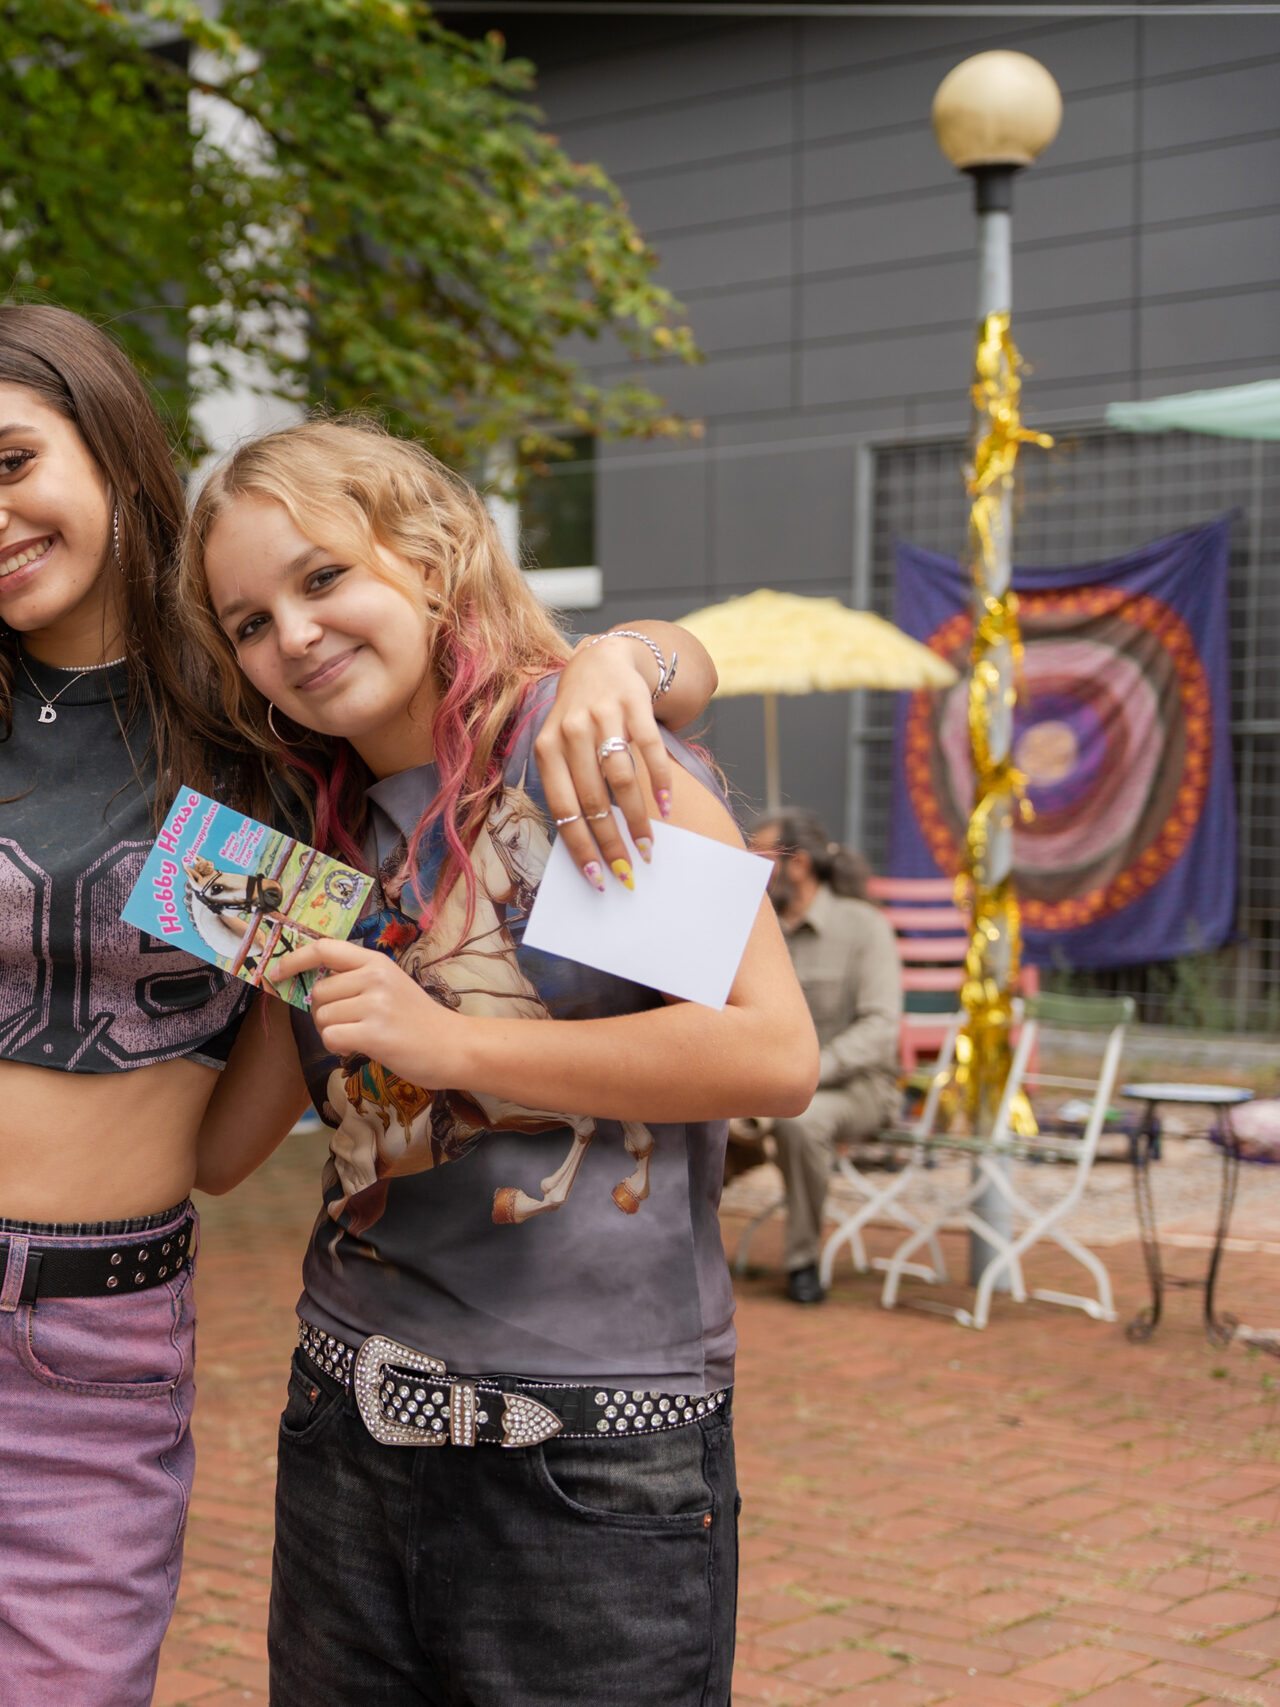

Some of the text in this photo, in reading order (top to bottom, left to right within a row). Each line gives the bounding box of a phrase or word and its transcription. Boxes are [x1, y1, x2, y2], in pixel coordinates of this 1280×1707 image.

[37, 703, 57, 724] D
[153, 793, 200, 935] Hobby Horse
[183, 803, 219, 865] Schnupperkurs
